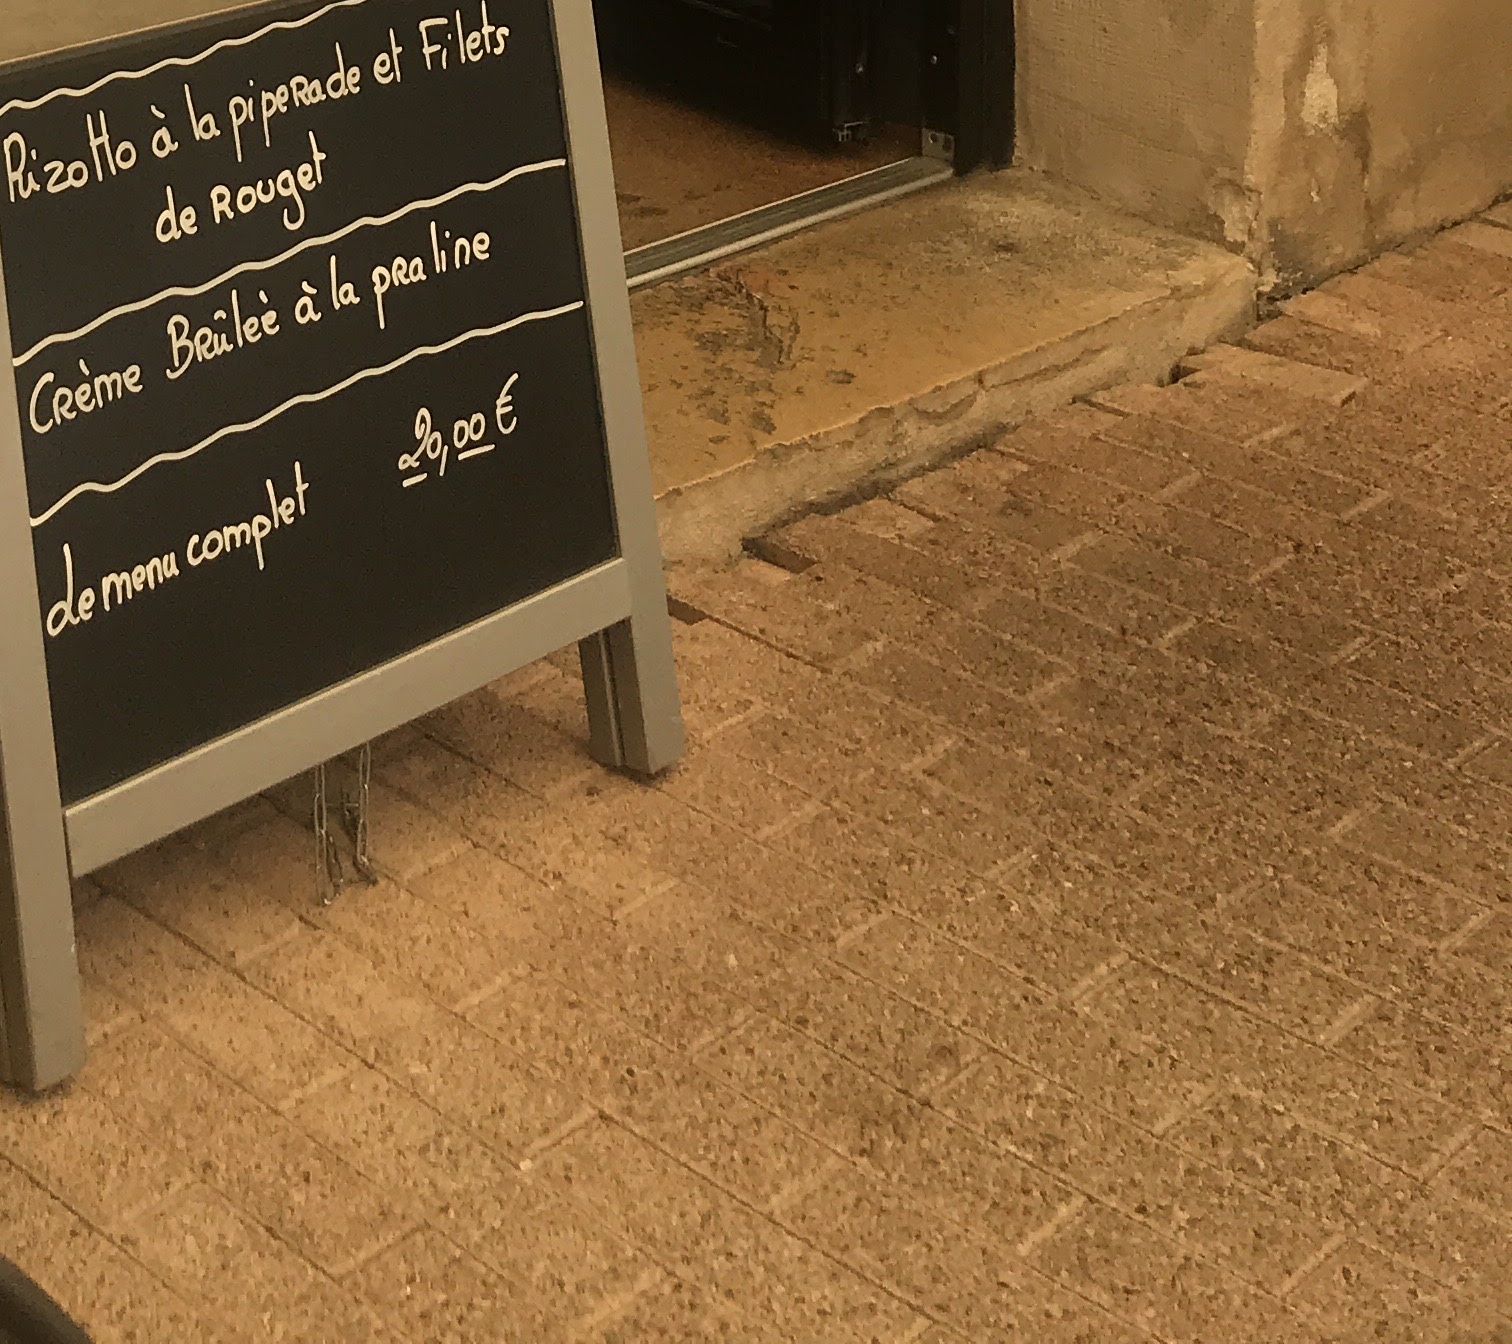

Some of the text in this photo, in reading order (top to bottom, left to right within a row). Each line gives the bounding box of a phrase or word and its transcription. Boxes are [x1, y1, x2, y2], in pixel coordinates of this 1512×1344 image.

[3, 0, 510, 203] Rizotto à la piperade et Filets
[156, 130, 327, 243] de Rouget
[29, 358, 143, 434] Crème
[294, 280, 322, 325] à
[329, 254, 360, 311] la
[101, 551, 180, 612] menu
[186, 461, 309, 572] complet
